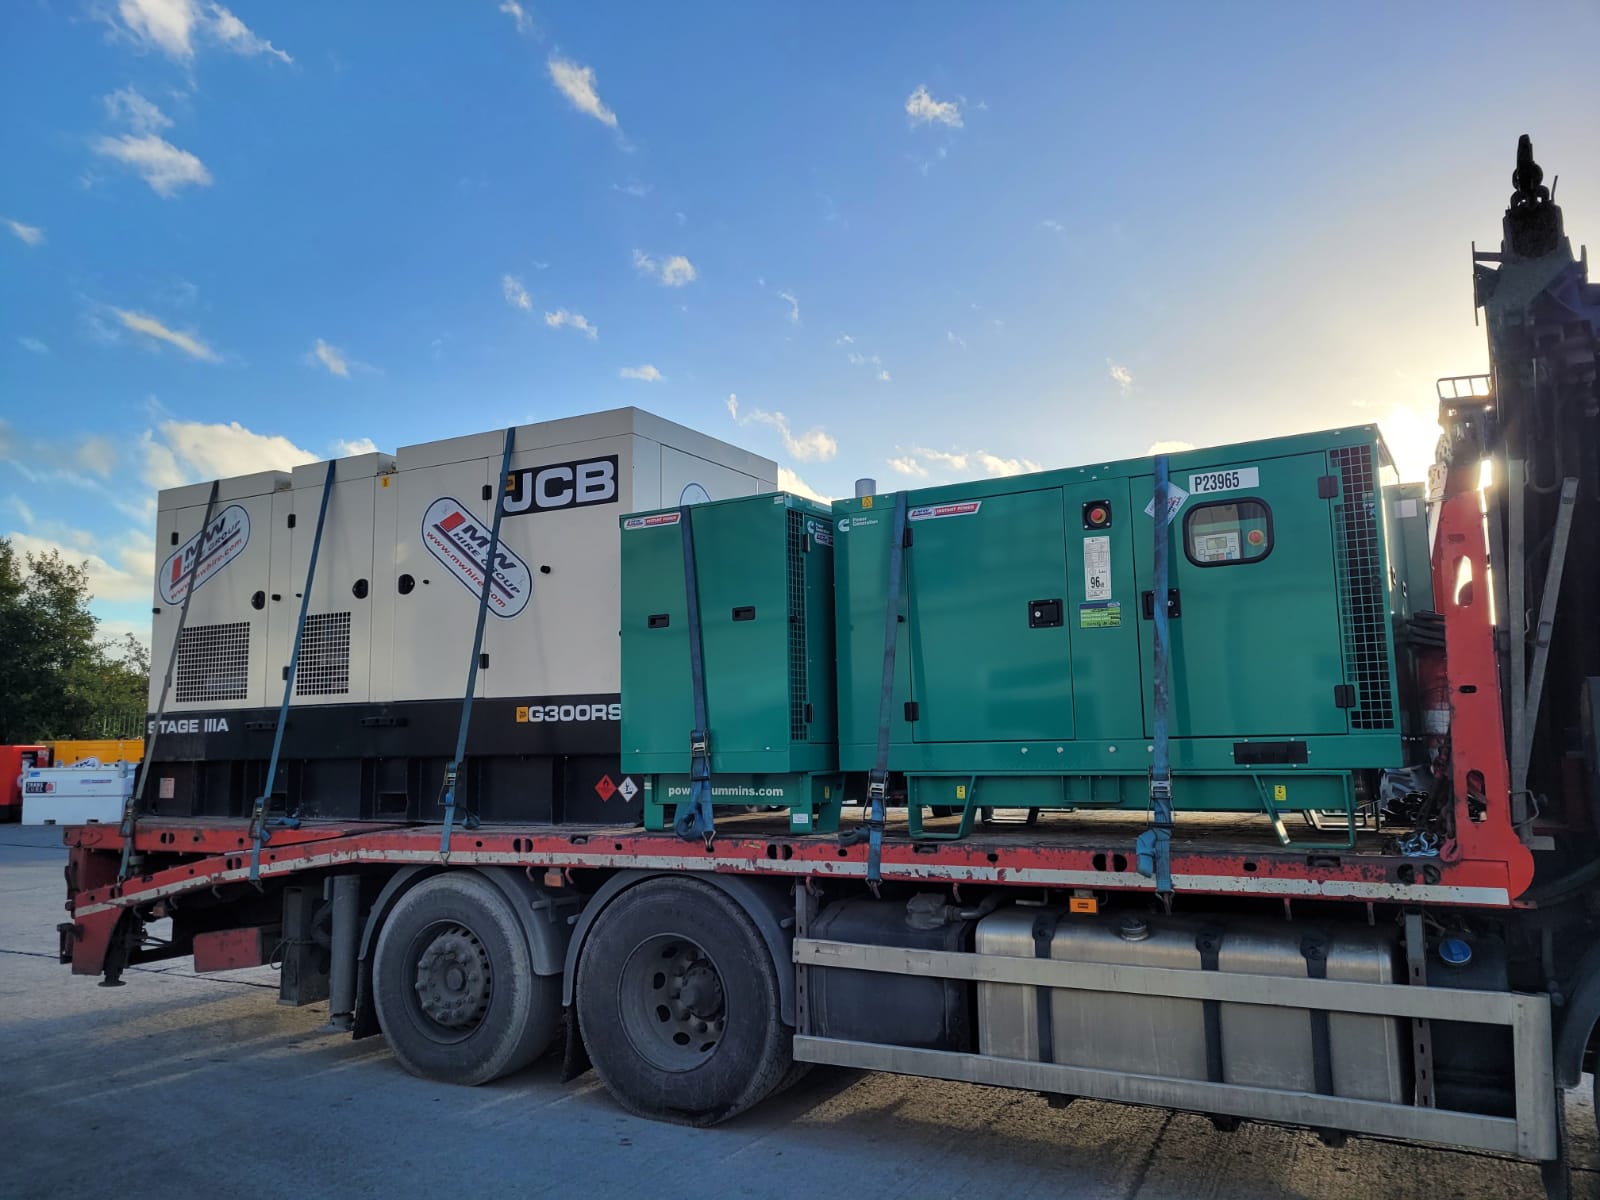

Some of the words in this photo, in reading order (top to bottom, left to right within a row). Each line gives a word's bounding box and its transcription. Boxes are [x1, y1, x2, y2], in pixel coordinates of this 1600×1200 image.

[502, 460, 615, 513] JCB
[1194, 471, 1240, 492] P23965
[452, 532, 481, 557] HIRE
[426, 531, 506, 608] www.mwhireom
[1090, 576, 1100, 588] 96
[528, 703, 621, 722] G300RS
[147, 719, 199, 734] STAGE
[668, 785, 784, 797] powummins.com
